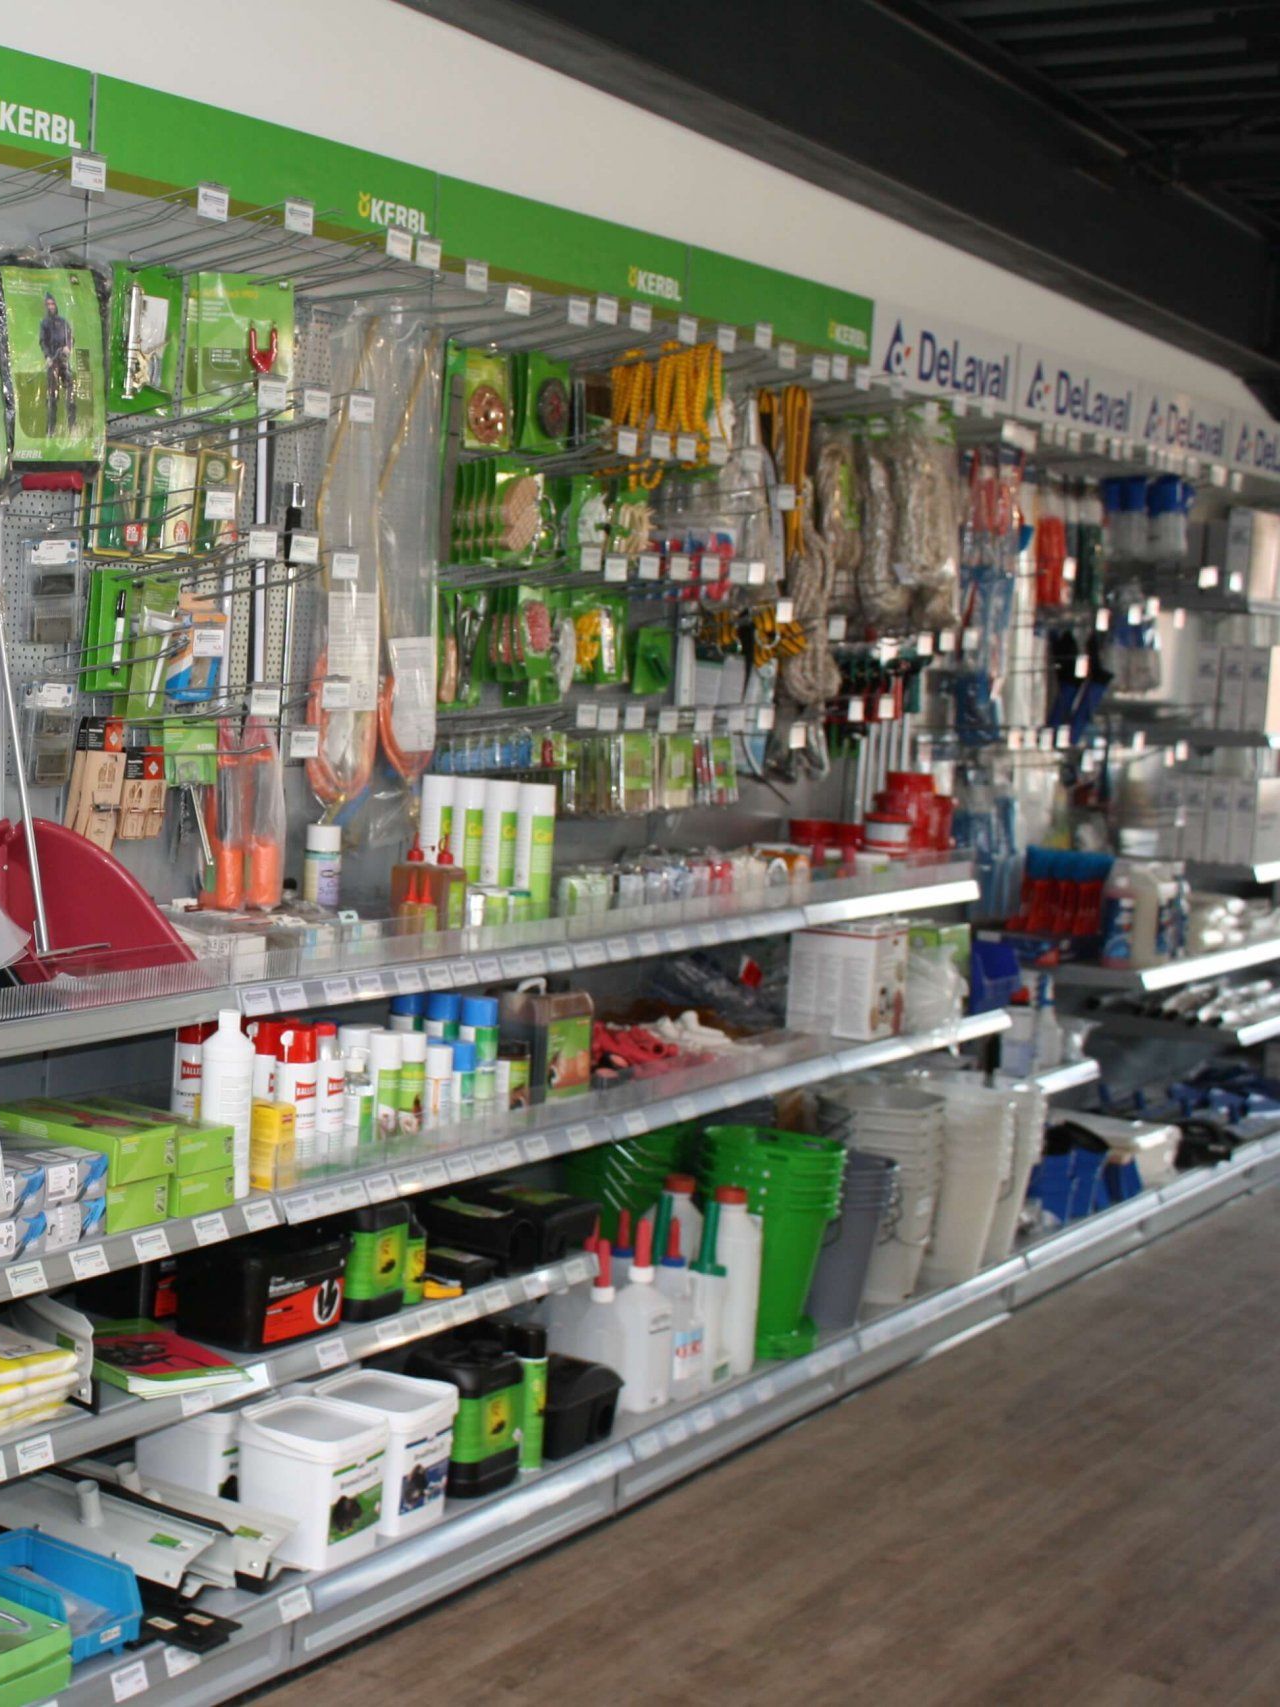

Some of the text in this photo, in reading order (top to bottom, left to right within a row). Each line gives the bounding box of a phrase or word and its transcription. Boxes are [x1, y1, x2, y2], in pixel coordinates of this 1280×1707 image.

[0, 101, 82, 149] KERBL
[637, 273, 682, 302] KERBL
[834, 325, 868, 351] KERBL
[918, 331, 1009, 400] DeLaval
[1055, 370, 1132, 433] DeLaval
[1165, 404, 1227, 457] DeLaval
